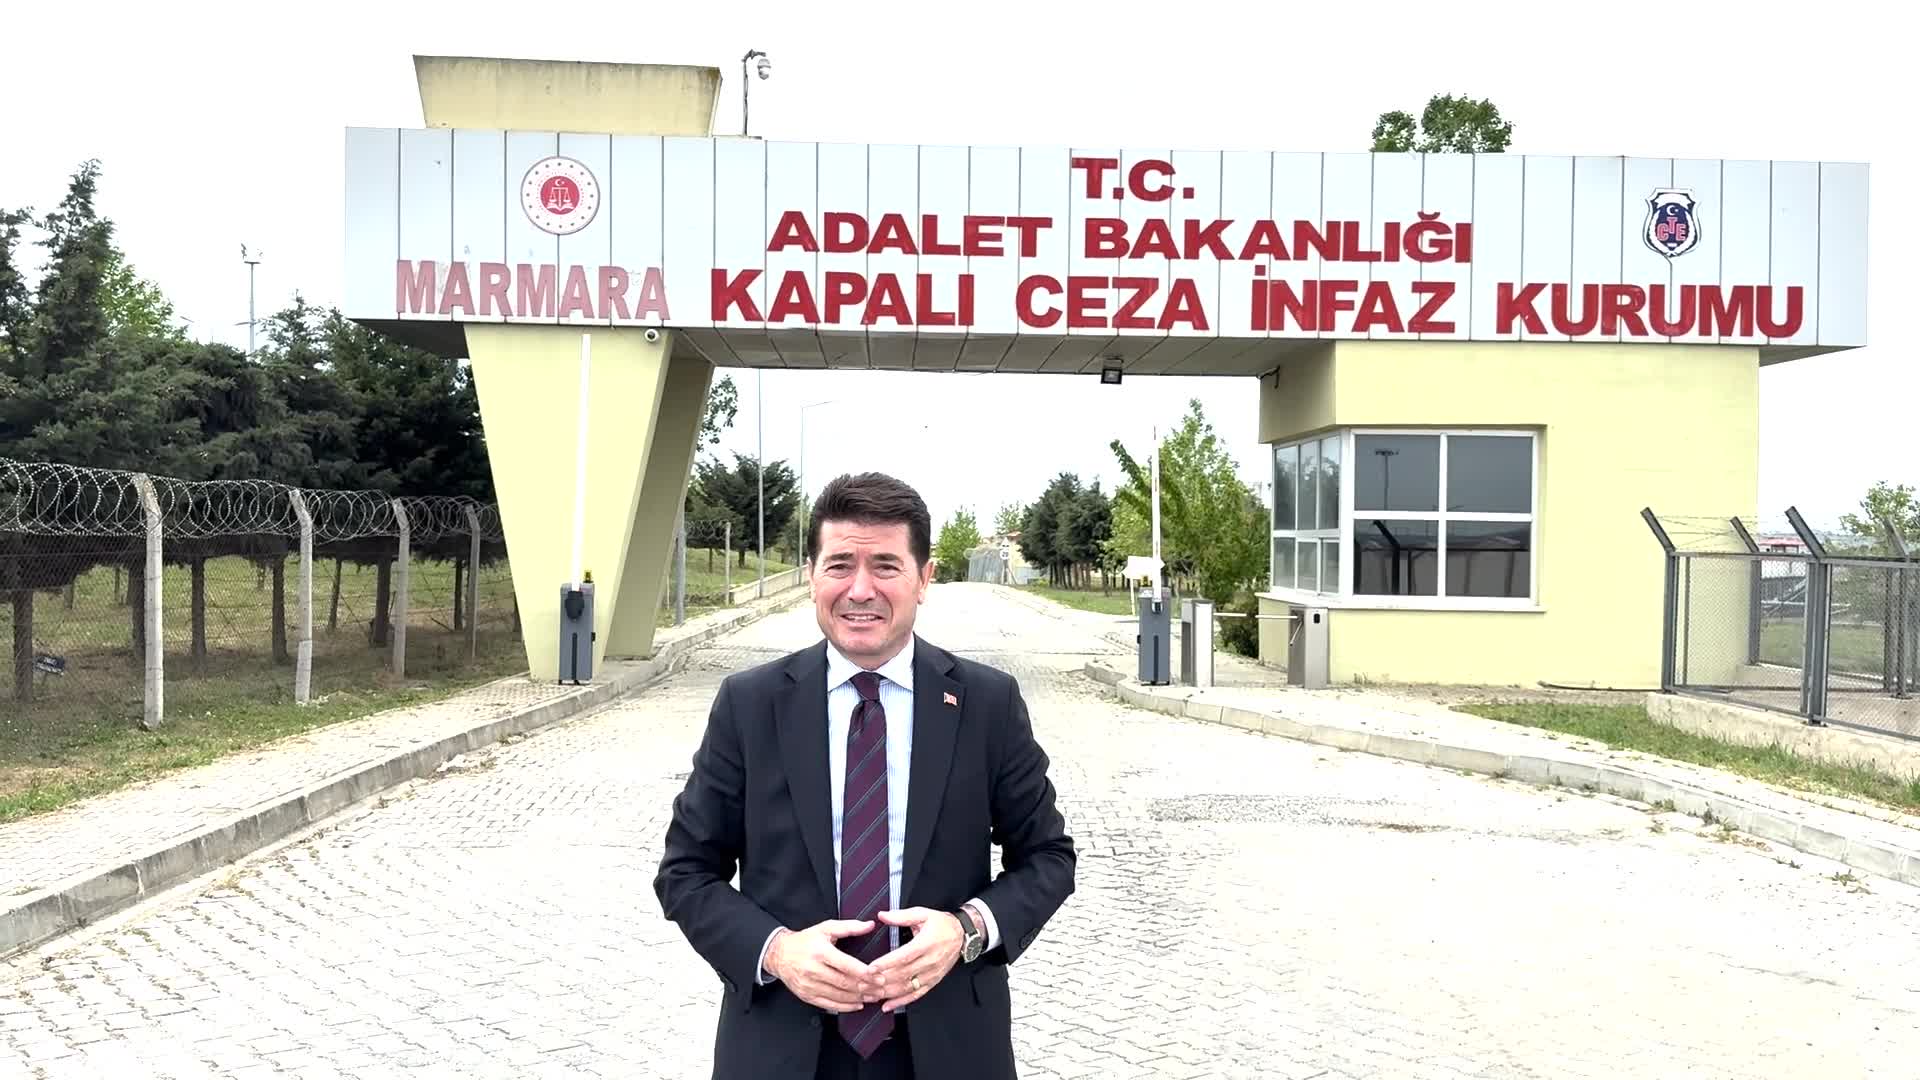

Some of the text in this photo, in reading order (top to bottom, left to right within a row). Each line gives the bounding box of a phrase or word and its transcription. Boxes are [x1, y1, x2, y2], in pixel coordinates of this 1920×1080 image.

[1072, 158, 1195, 202] T.C.
[767, 211, 1473, 263] ADALET BAKANLIĞI
[1657, 216, 1687, 241] CTE
[396, 260, 1804, 338] MARMARA KAPALI CEZA İNFAZ KURUMU
